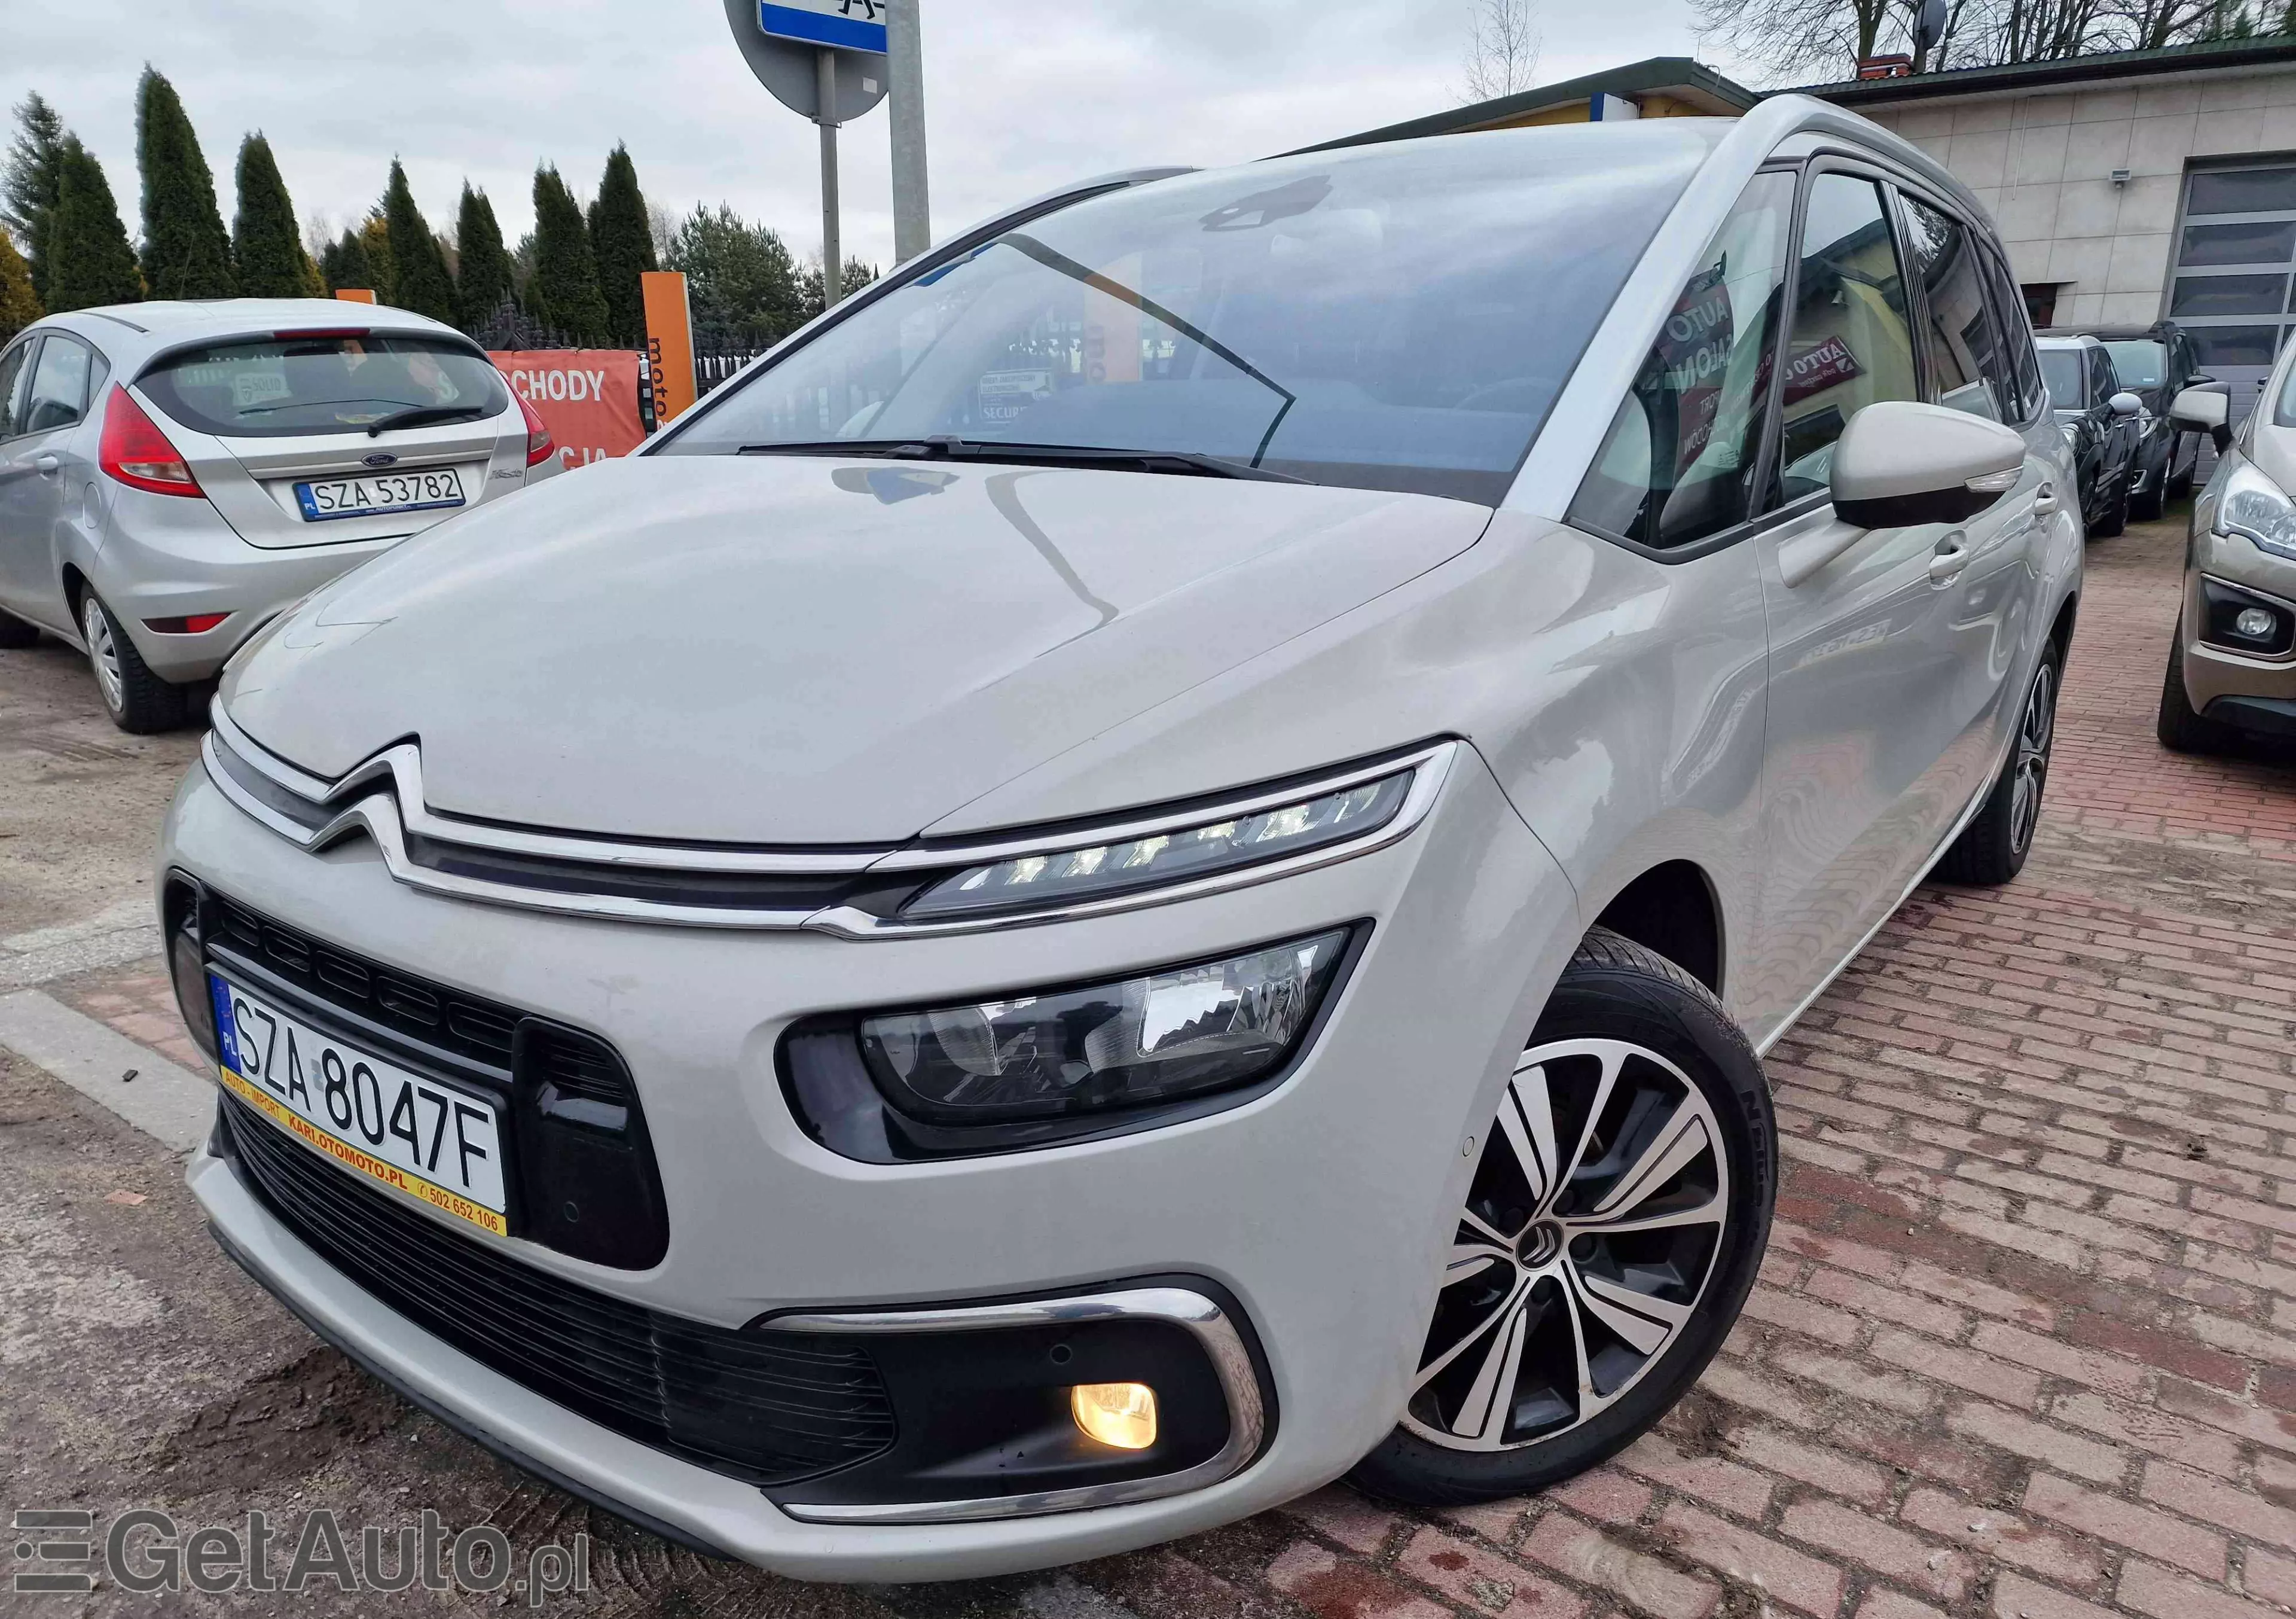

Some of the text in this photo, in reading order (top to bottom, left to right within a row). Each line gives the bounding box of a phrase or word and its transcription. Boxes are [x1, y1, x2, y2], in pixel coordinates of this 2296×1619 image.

[649, 337, 668, 417] moto
[984, 406, 1028, 419] SECUR
[369, 455, 390, 465] Ford
[315, 481, 371, 510] SZA
[375, 474, 458, 503] 53782
[223, 998, 489, 1188] PL SZA 8047F
[225, 1071, 246, 1094] AUTO
[251, 1088, 280, 1118] IMPORT
[288, 1114, 408, 1190] KARI.OTOMOTO.PL
[430, 1187, 450, 1209] 502
[453, 1198, 474, 1221] 652
[477, 1209, 499, 1231] 106
